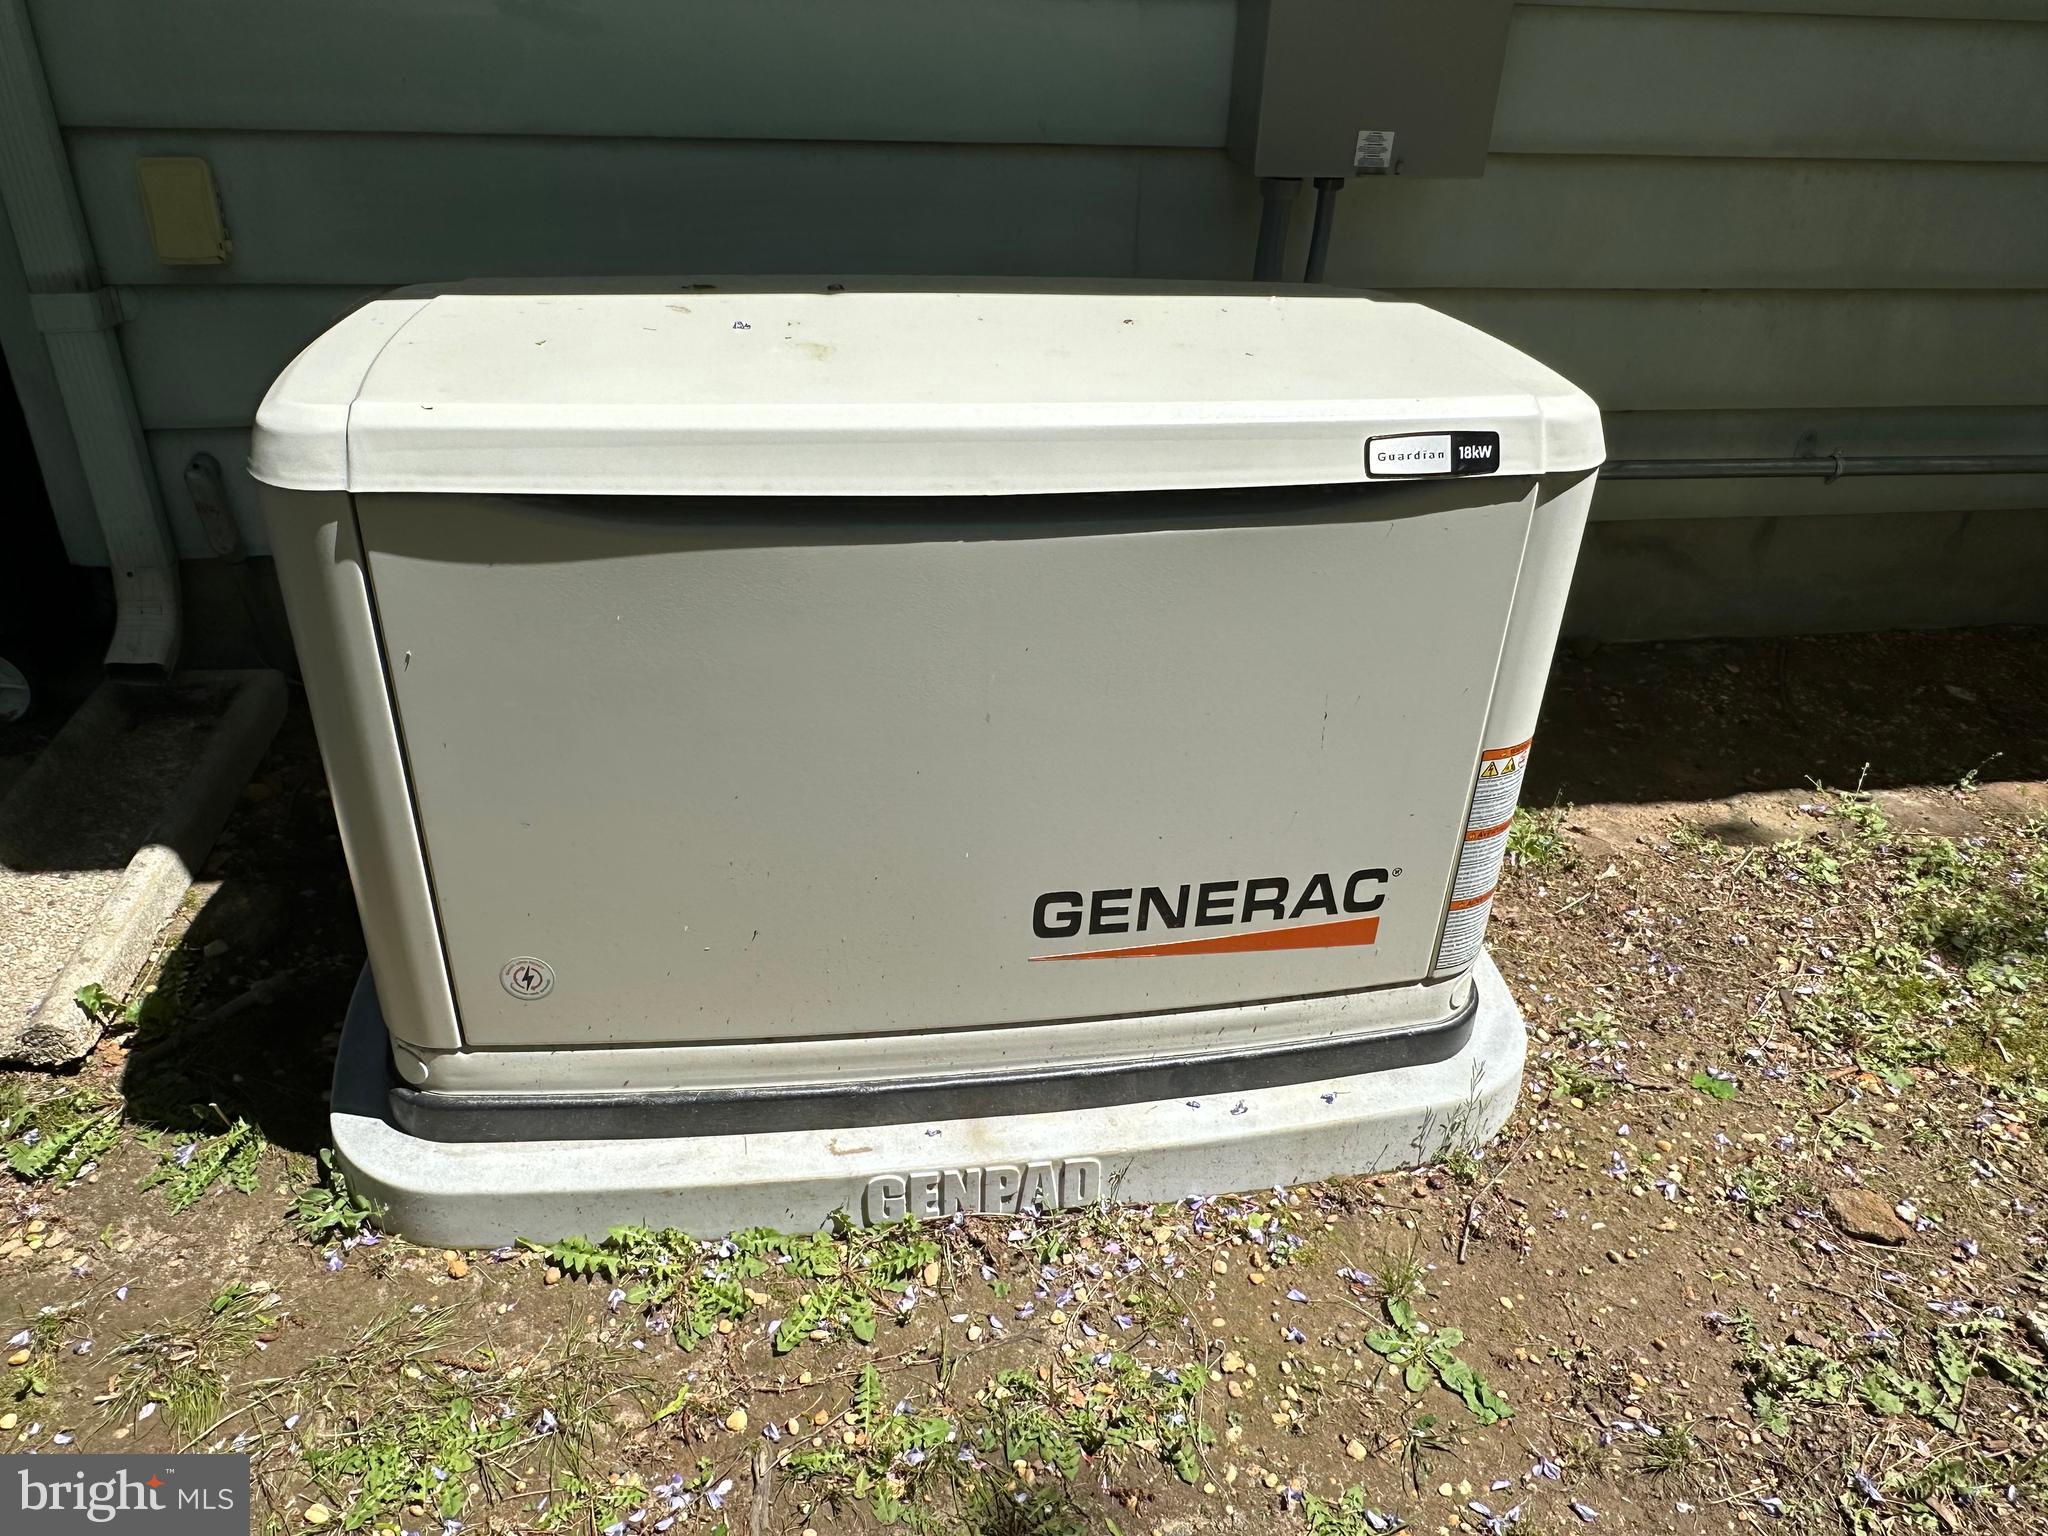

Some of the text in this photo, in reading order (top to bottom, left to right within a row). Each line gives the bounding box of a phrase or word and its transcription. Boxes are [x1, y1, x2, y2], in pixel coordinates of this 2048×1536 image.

[1377, 445, 1493, 462] Guardian 18kW
[861, 1157, 1101, 1228] GENPAD
